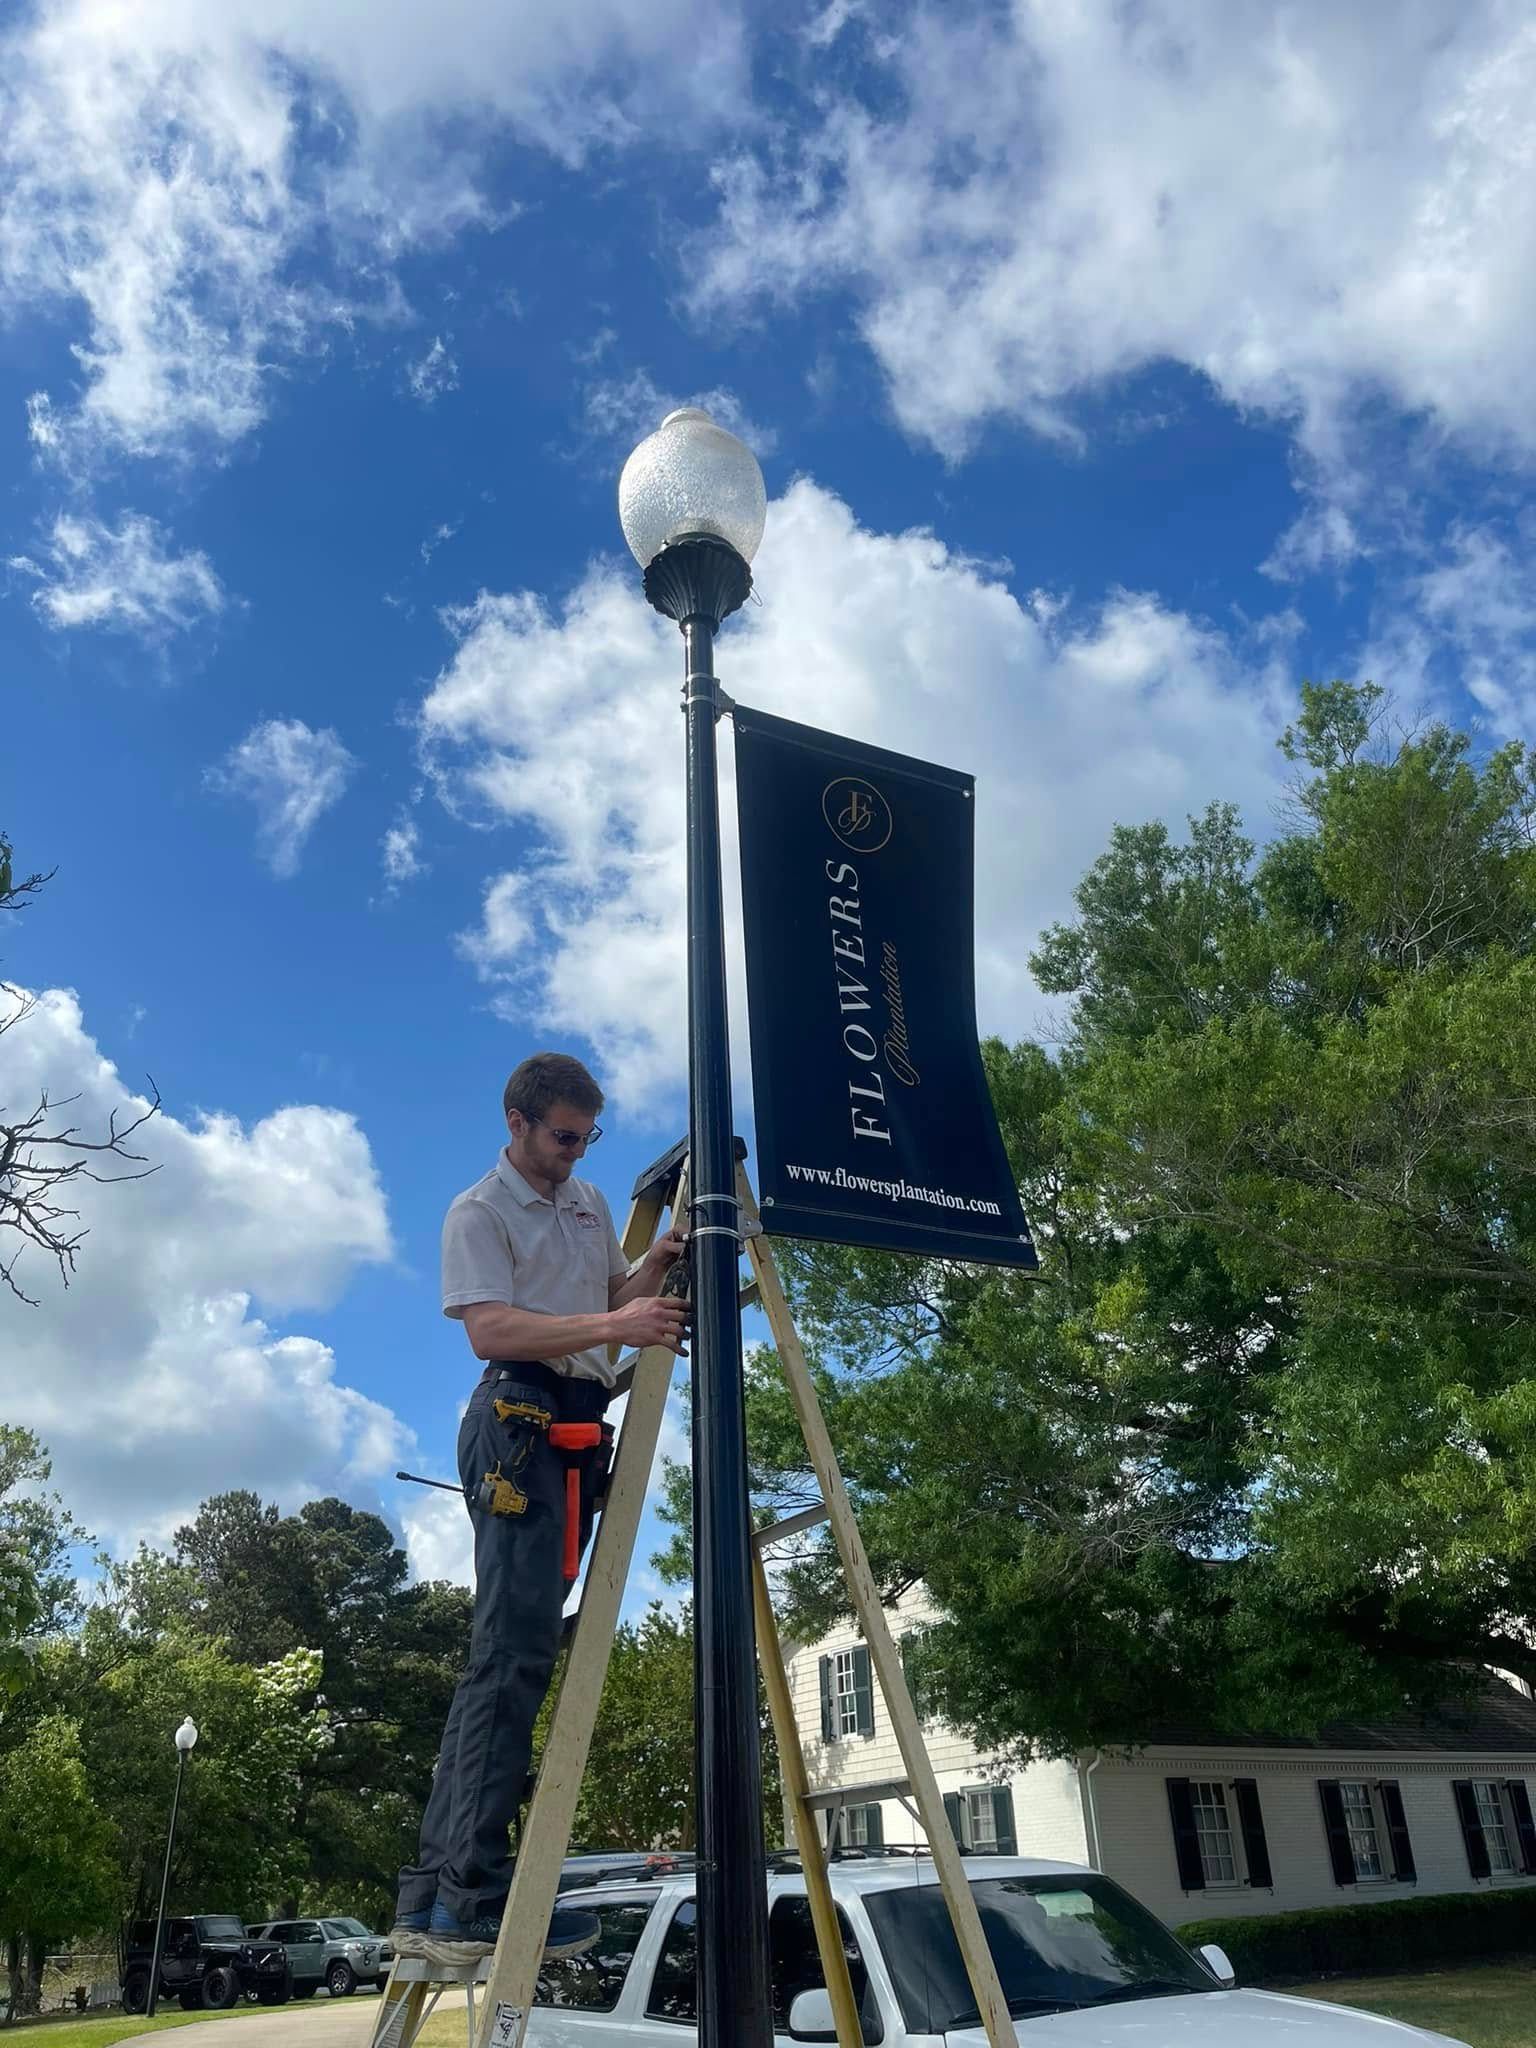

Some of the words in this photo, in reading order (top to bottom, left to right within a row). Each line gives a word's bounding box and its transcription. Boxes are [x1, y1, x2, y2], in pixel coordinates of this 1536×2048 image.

[825, 858, 893, 1146] FLOWERS
[882, 939, 921, 1087] Plantation
[785, 1162, 1002, 1217] www.flowersplantation.com
